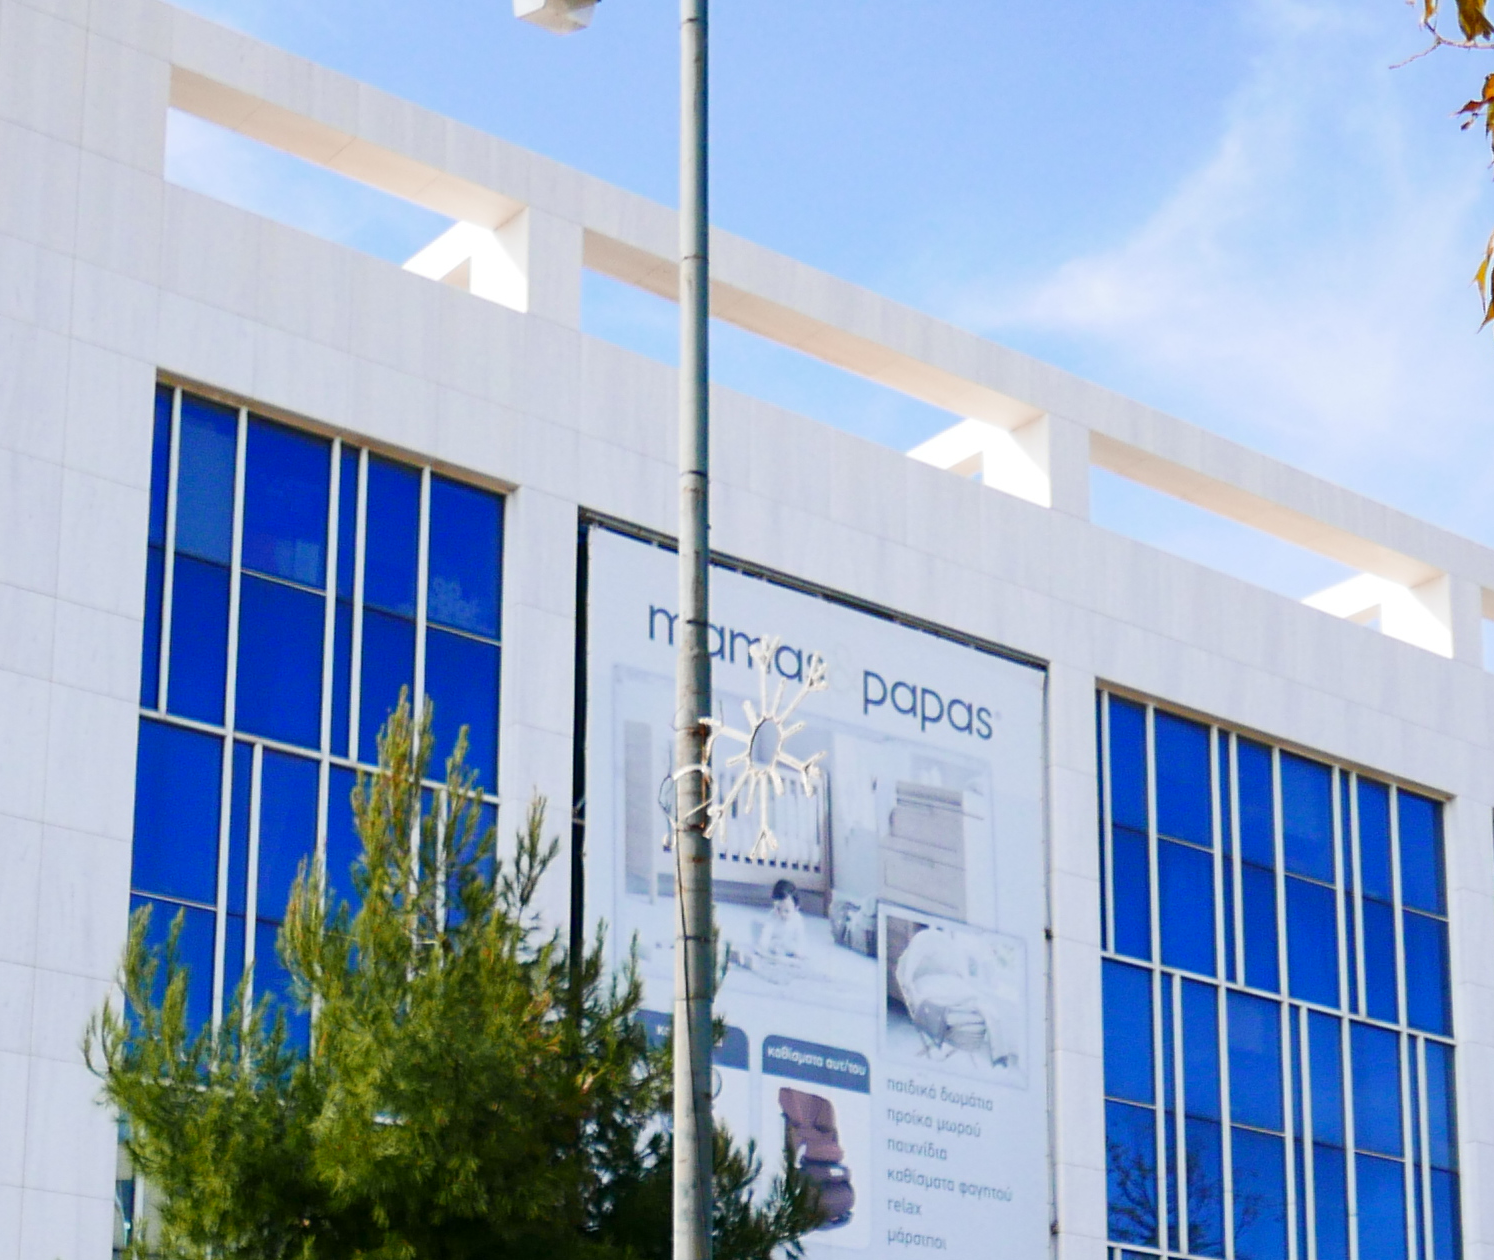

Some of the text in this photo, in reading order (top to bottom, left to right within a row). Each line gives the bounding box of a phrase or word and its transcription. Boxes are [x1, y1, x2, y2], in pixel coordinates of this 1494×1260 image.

[648, 604, 826, 684] mamas
[862, 669, 993, 740] papas
[767, 1044, 867, 1077] καθίσματα αυτ/του
[887, 1077, 993, 1111] παιδικά δωμάτια
[887, 1107, 982, 1138] προίκα μωρού
[887, 1138, 948, 1161] παιχνίδια
[887, 1168, 1013, 1203] καθίσματα φαγητού
[887, 1197, 922, 1216] relax
[887, 1227, 947, 1251] μάρσιποι
